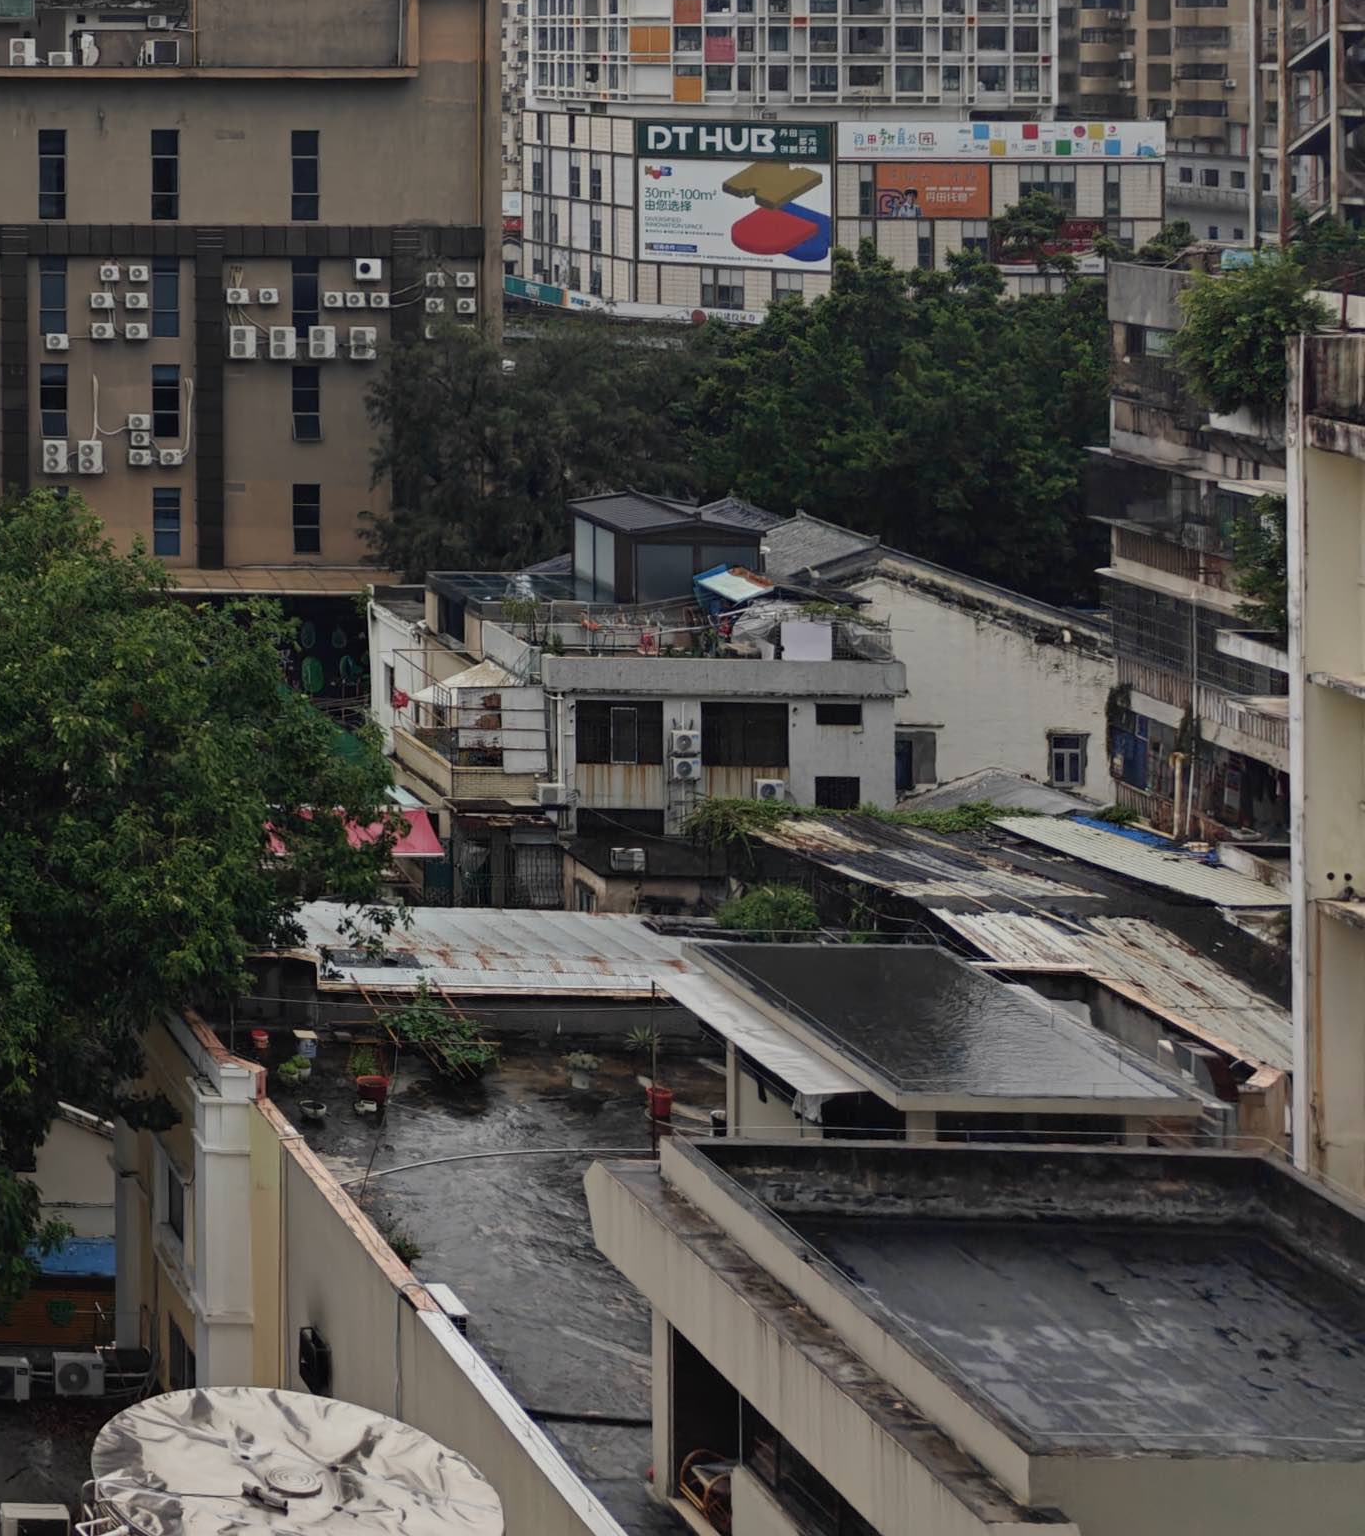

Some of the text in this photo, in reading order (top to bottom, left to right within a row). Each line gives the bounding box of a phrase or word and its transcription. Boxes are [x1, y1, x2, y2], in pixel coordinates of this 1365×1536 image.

[647, 125, 776, 154] DT HUB
[644, 199, 692, 212] 由您选择
